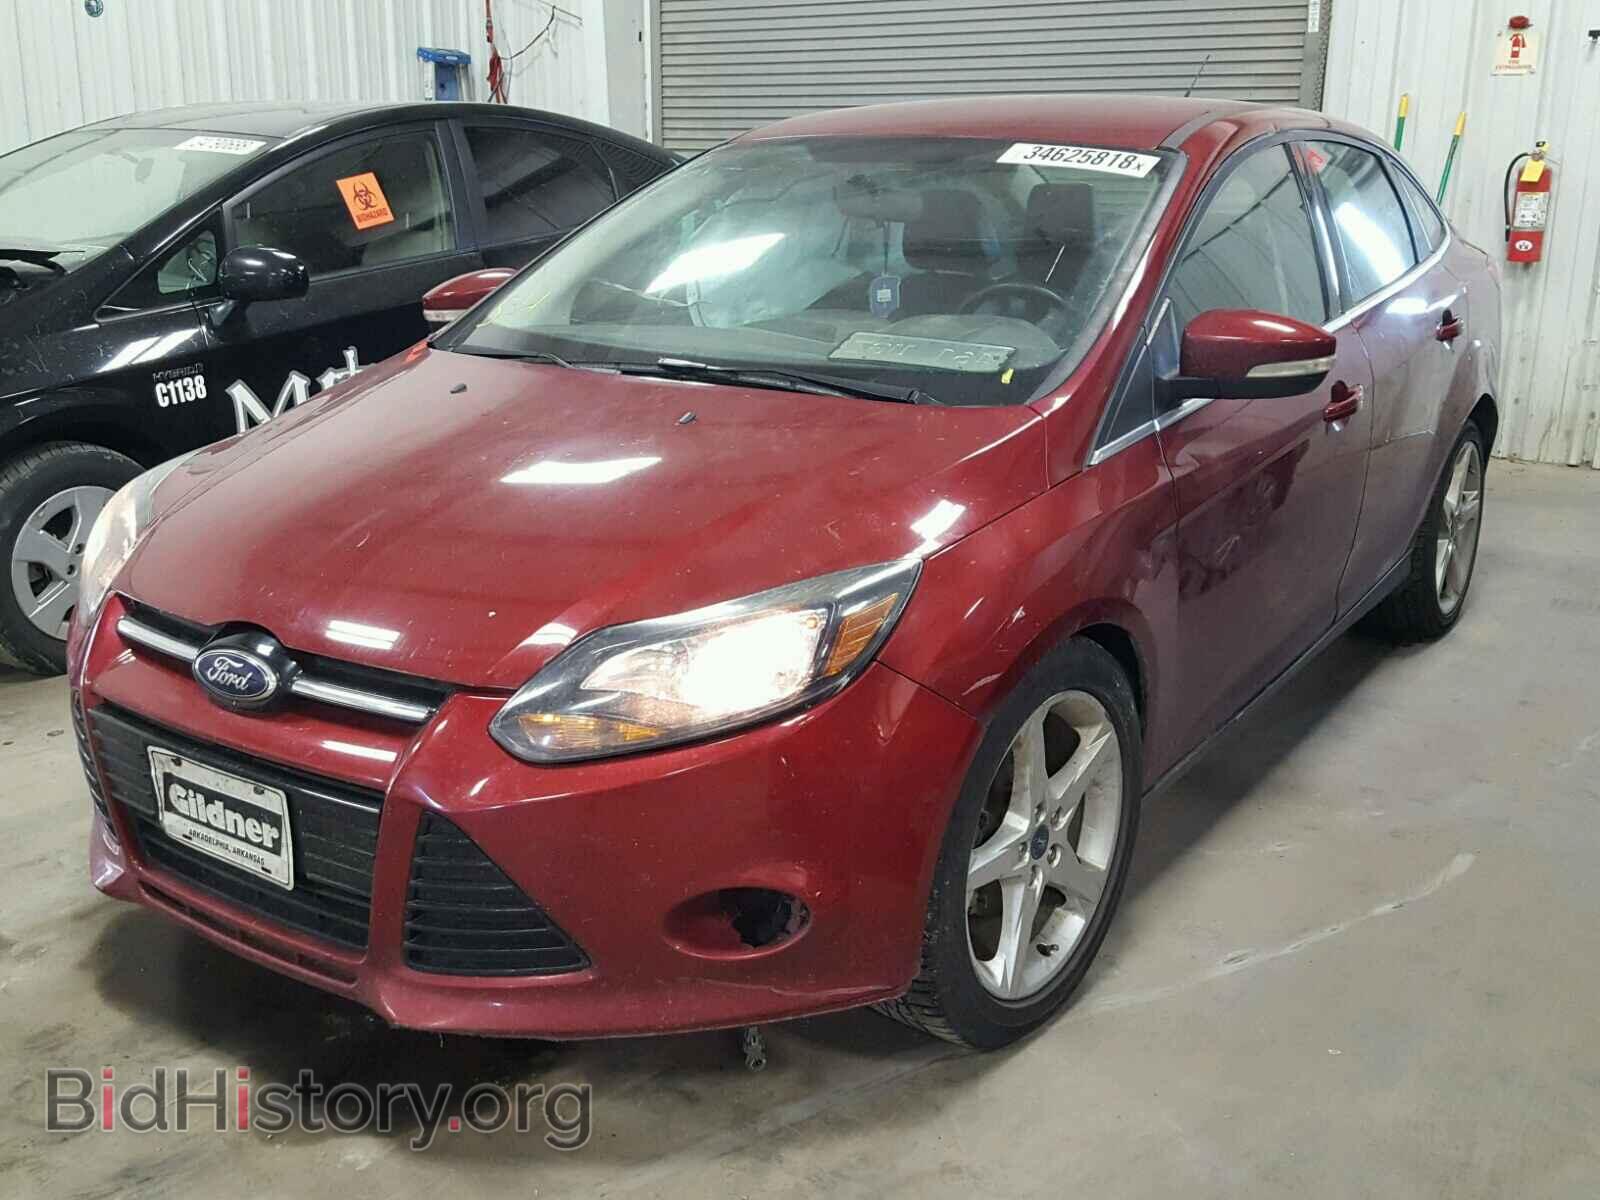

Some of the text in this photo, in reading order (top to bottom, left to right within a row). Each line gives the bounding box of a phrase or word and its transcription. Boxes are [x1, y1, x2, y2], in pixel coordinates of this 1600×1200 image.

[155, 374, 208, 408] C1138
[207, 656, 253, 690] Ford
[168, 783, 280, 849] Gildner
[231, 846, 265, 867] ARKANSAS
